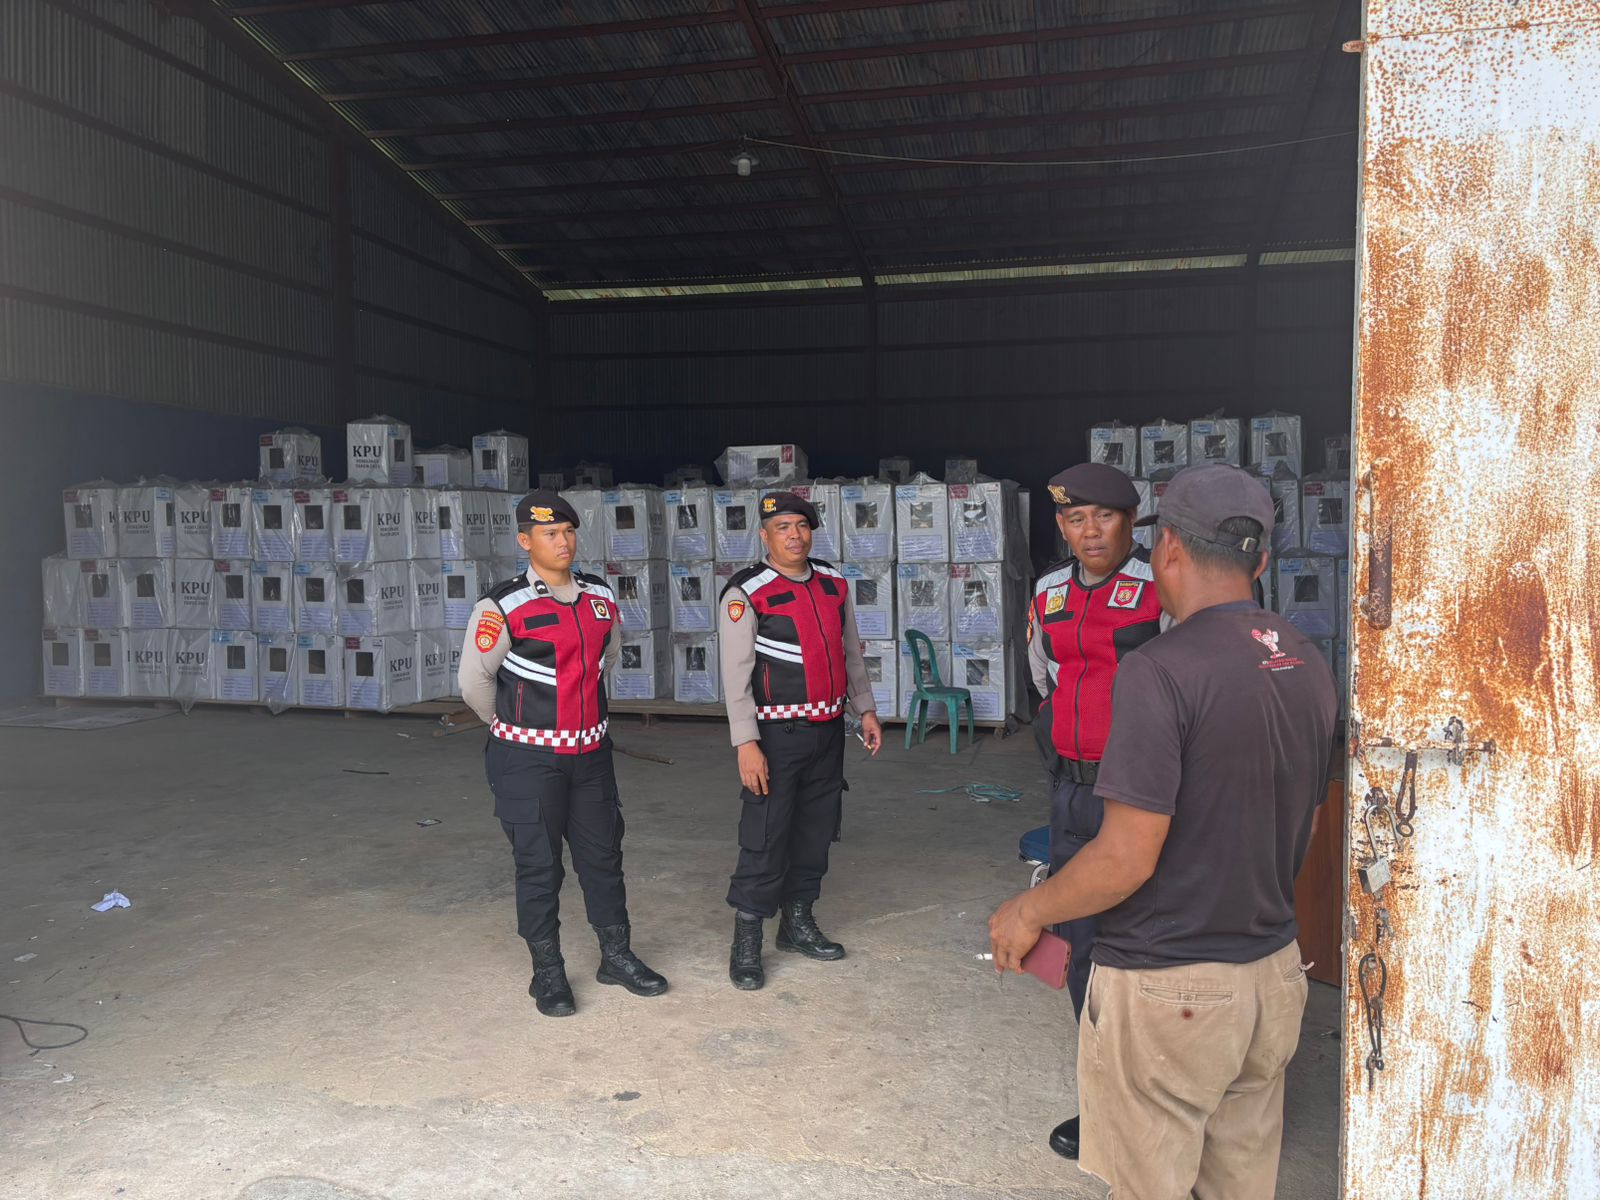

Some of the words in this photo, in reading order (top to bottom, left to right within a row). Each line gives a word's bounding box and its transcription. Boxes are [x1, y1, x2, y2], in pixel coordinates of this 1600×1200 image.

[352, 445, 382, 457] KPU
[298, 455, 318, 466] KPU
[510, 455, 527, 467] KPU
[124, 510, 150, 523] KPU
[181, 511, 209, 523] KPU
[377, 513, 400, 526] KPU
[415, 511, 437, 524] KPU
[466, 513, 486, 525] KPU
[492, 514, 511, 525] KPU
[181, 582, 210, 594] KPU
[381, 585, 405, 599] KPU
[417, 583, 440, 595] KPU
[135, 651, 163, 663] KPU
[175, 652, 205, 664] KPU
[390, 657, 412, 672] KPU
